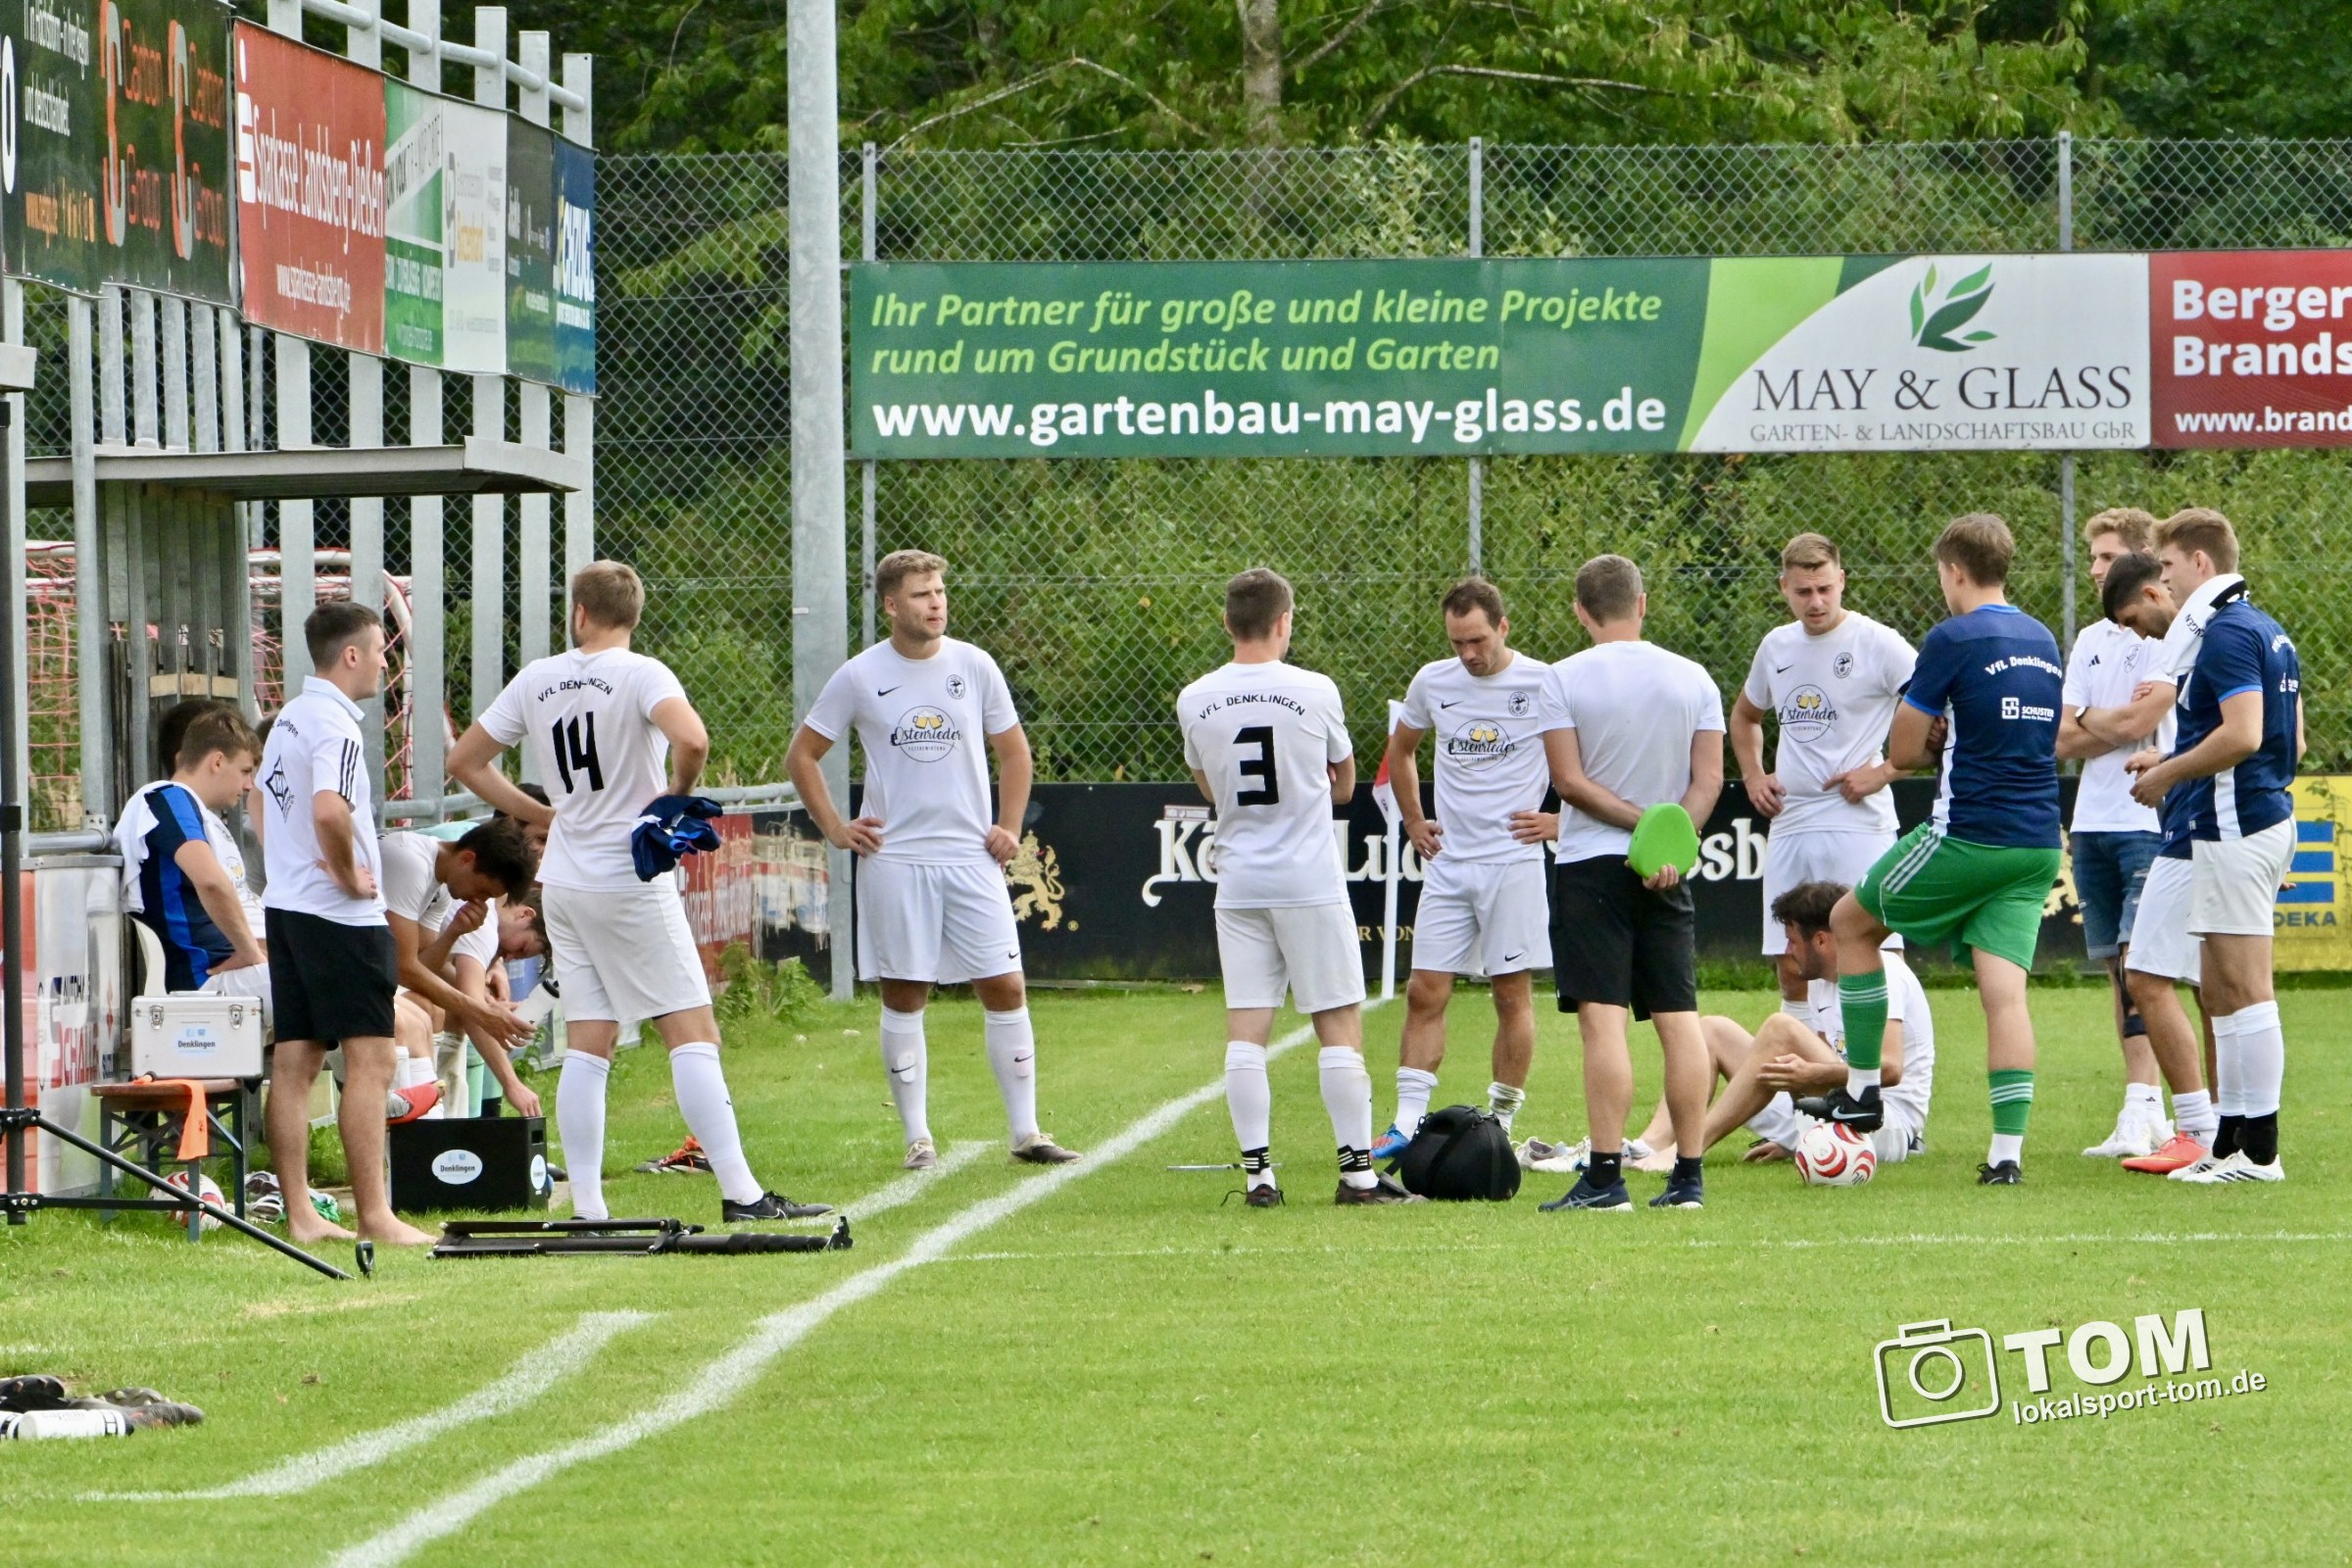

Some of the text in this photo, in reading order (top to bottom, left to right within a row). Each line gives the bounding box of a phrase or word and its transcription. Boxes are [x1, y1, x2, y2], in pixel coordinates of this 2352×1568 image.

[254, 103, 299, 229] Sparkasse
[300, 122, 383, 255] Landsberg-Dießen
[871, 287, 1662, 332] Ihr Partner für große und kleine Projekte
[871, 337, 1499, 374] rund um Grundstück und Garten
[1751, 366, 2133, 413] MAY & GLASS
[872, 387, 1666, 447] www.gartenbau-may-glass.de
[1750, 420, 2135, 443] GARTEN- & LANDSCHAFTSBAU GbR
[1984, 656, 2063, 678] VfL Denklingen
[537, 687, 556, 702] VFL
[1200, 694, 1305, 719] VFL DENKLINGEN
[2021, 706, 2055, 717] SCHUSTER
[552, 710, 605, 795] 14
[1232, 725, 1279, 807] 3
[2273, 910, 2338, 927] DEKA
[177, 1039, 216, 1050] Denklingen
[440, 1164, 475, 1175] Denklingen
